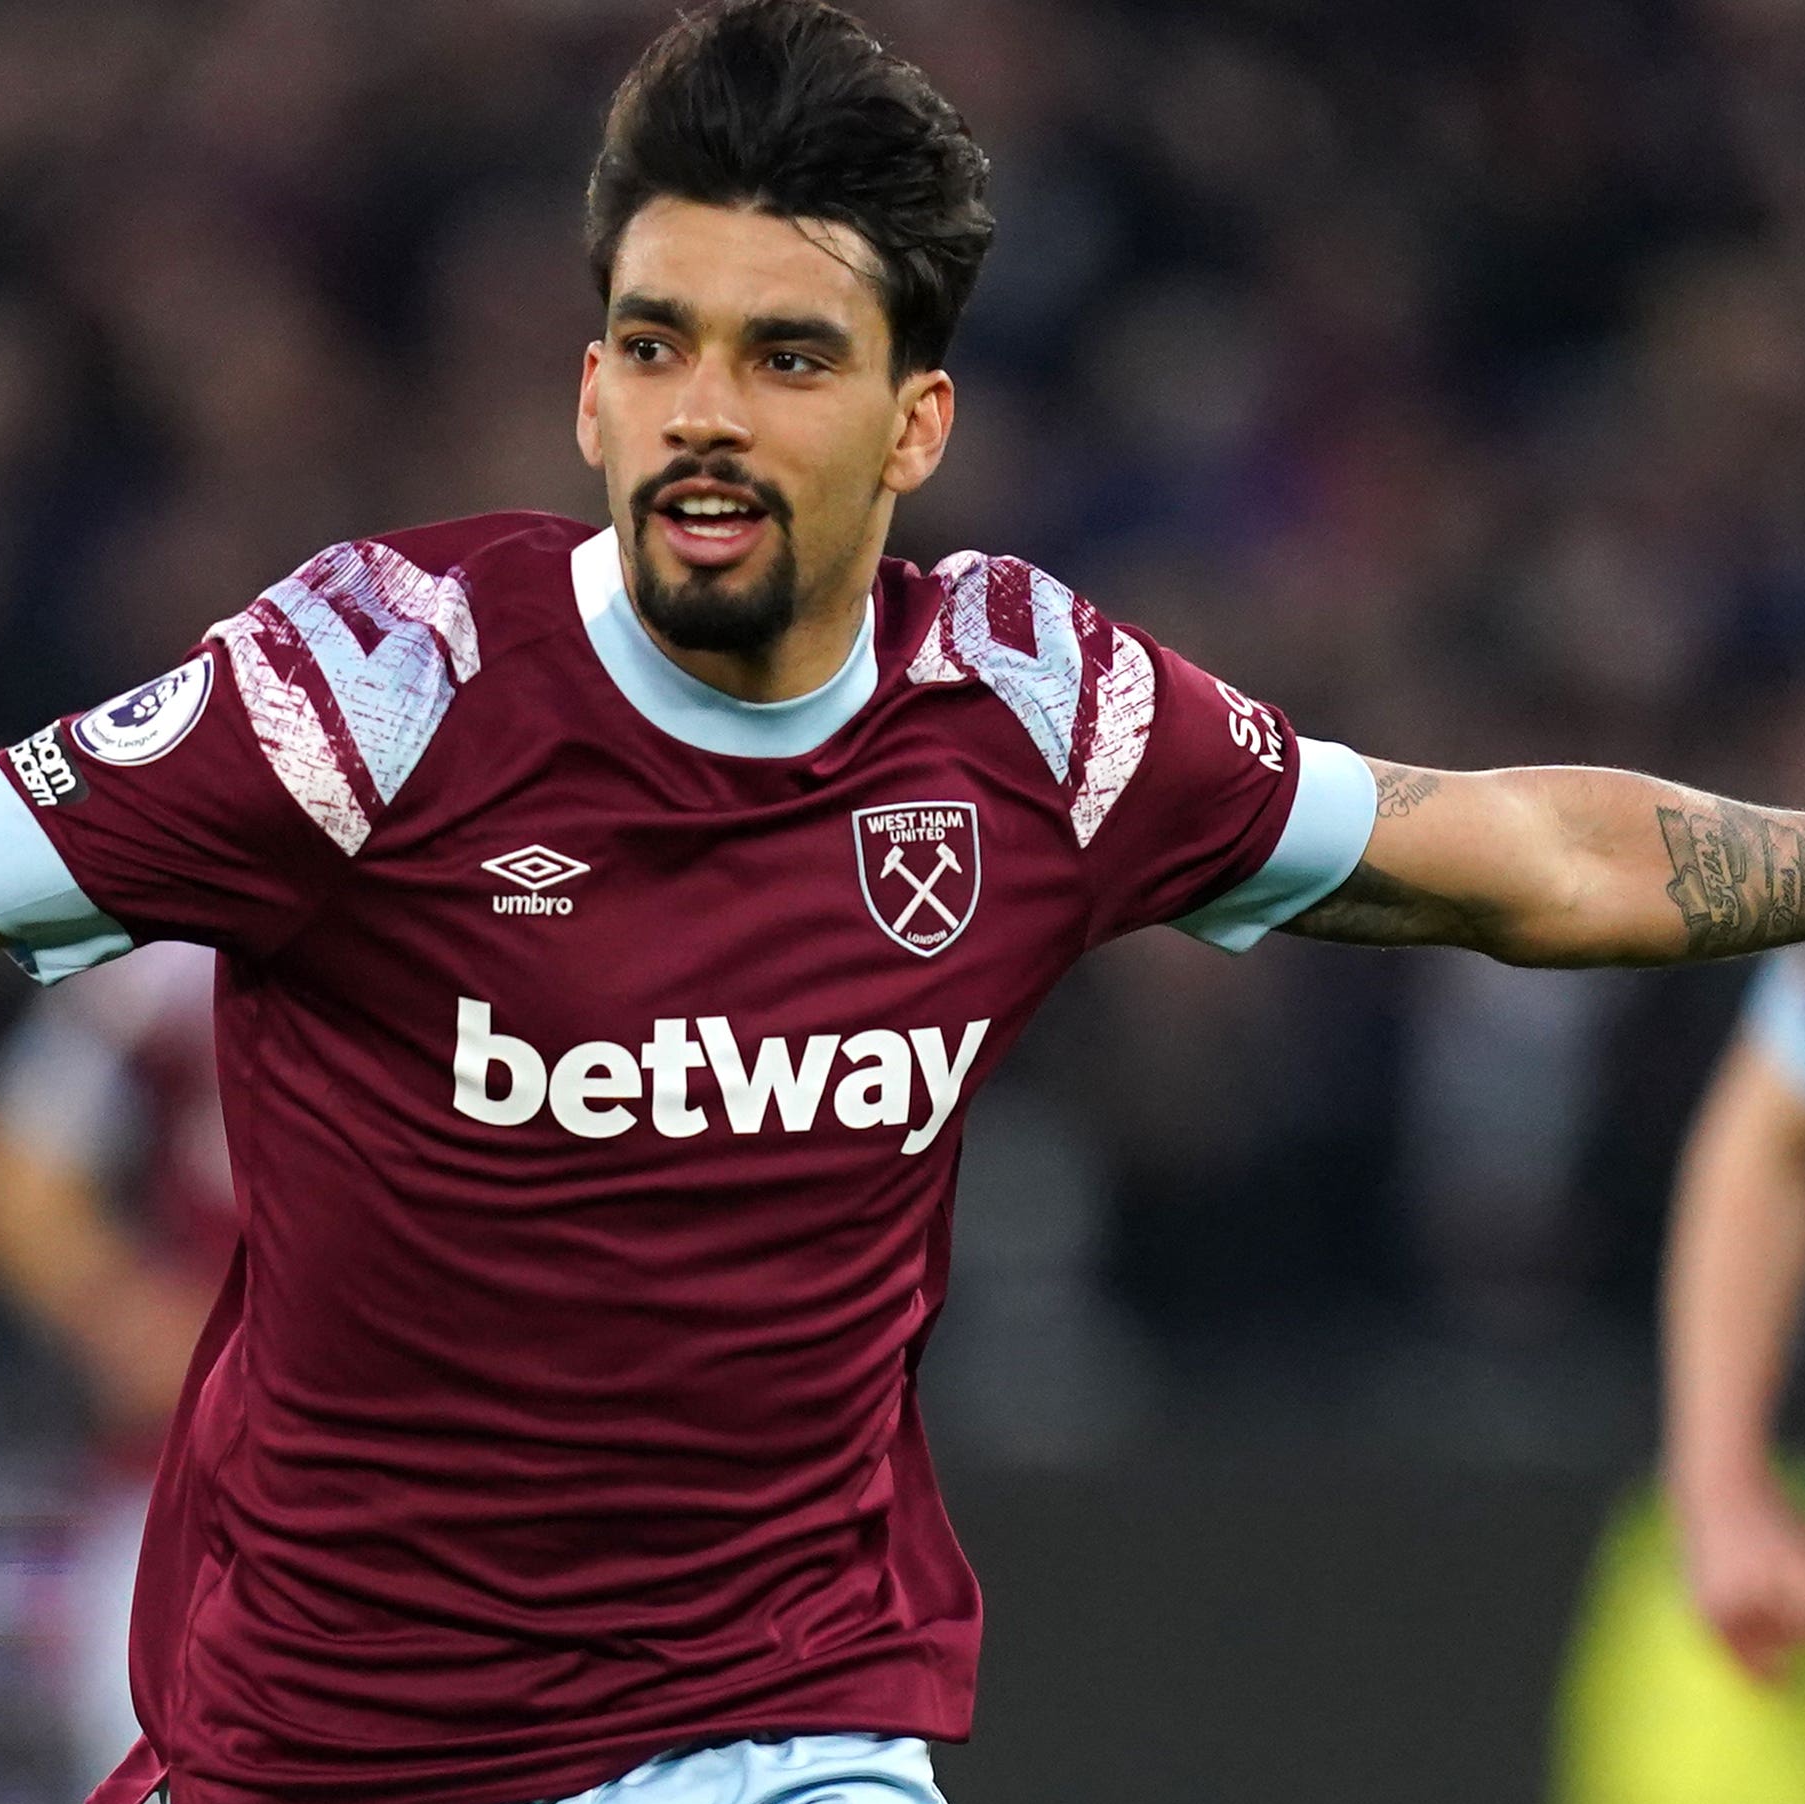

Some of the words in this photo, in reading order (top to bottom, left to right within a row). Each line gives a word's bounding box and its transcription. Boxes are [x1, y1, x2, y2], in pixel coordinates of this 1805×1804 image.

[867, 811, 918, 834] WEST
[920, 810, 965, 828] HAM
[890, 827, 946, 844] UNITED
[492, 891, 574, 916] umbro
[906, 930, 948, 945] LONDON
[452, 995, 992, 1155] betway
